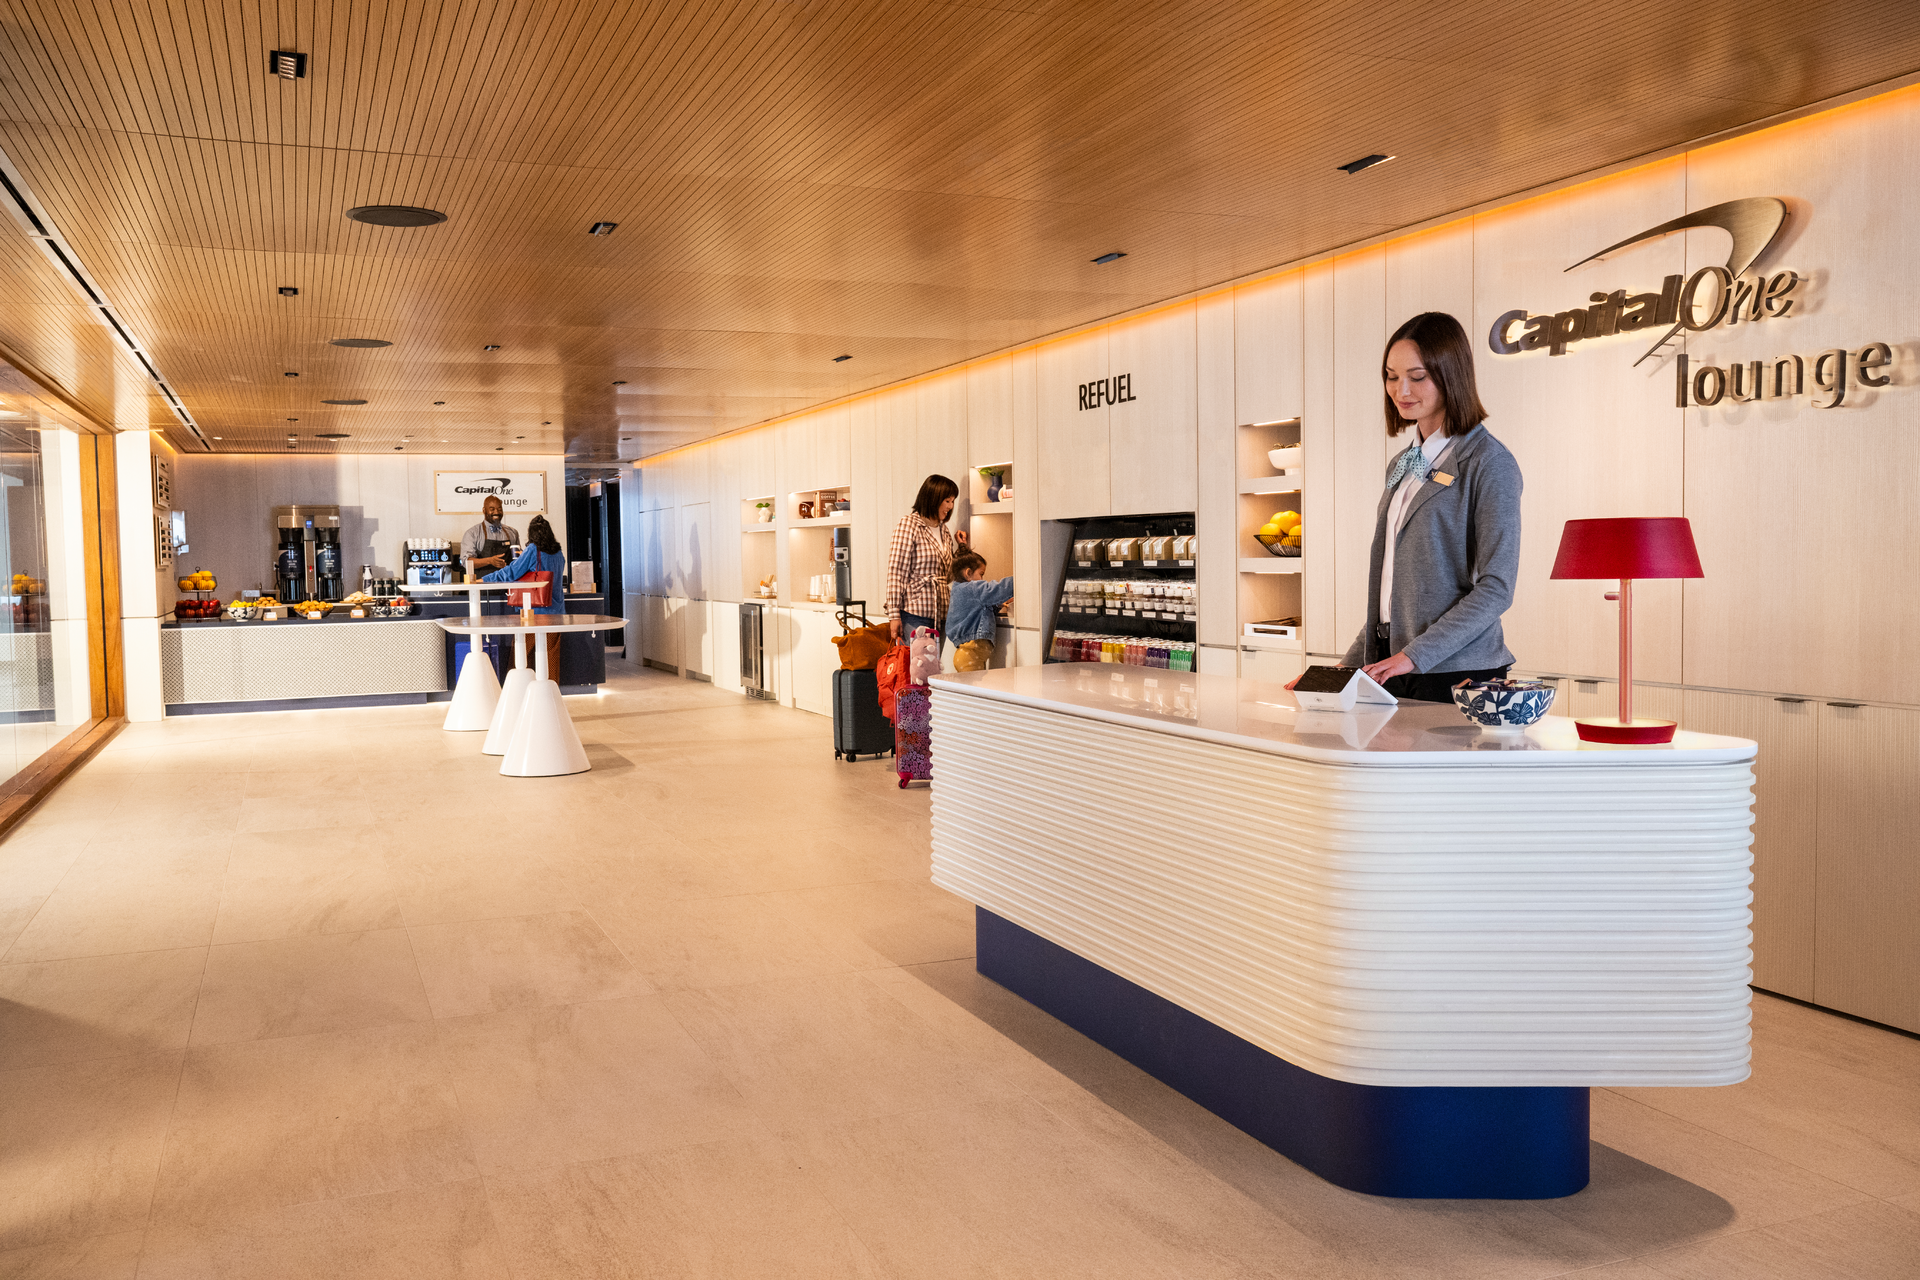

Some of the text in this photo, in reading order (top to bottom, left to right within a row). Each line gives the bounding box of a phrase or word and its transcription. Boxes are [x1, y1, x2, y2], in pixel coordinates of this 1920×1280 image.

[1079, 373, 1136, 411] REFUEL
[1676, 342, 1892, 409] lounge
[503, 499, 528, 508] unge
